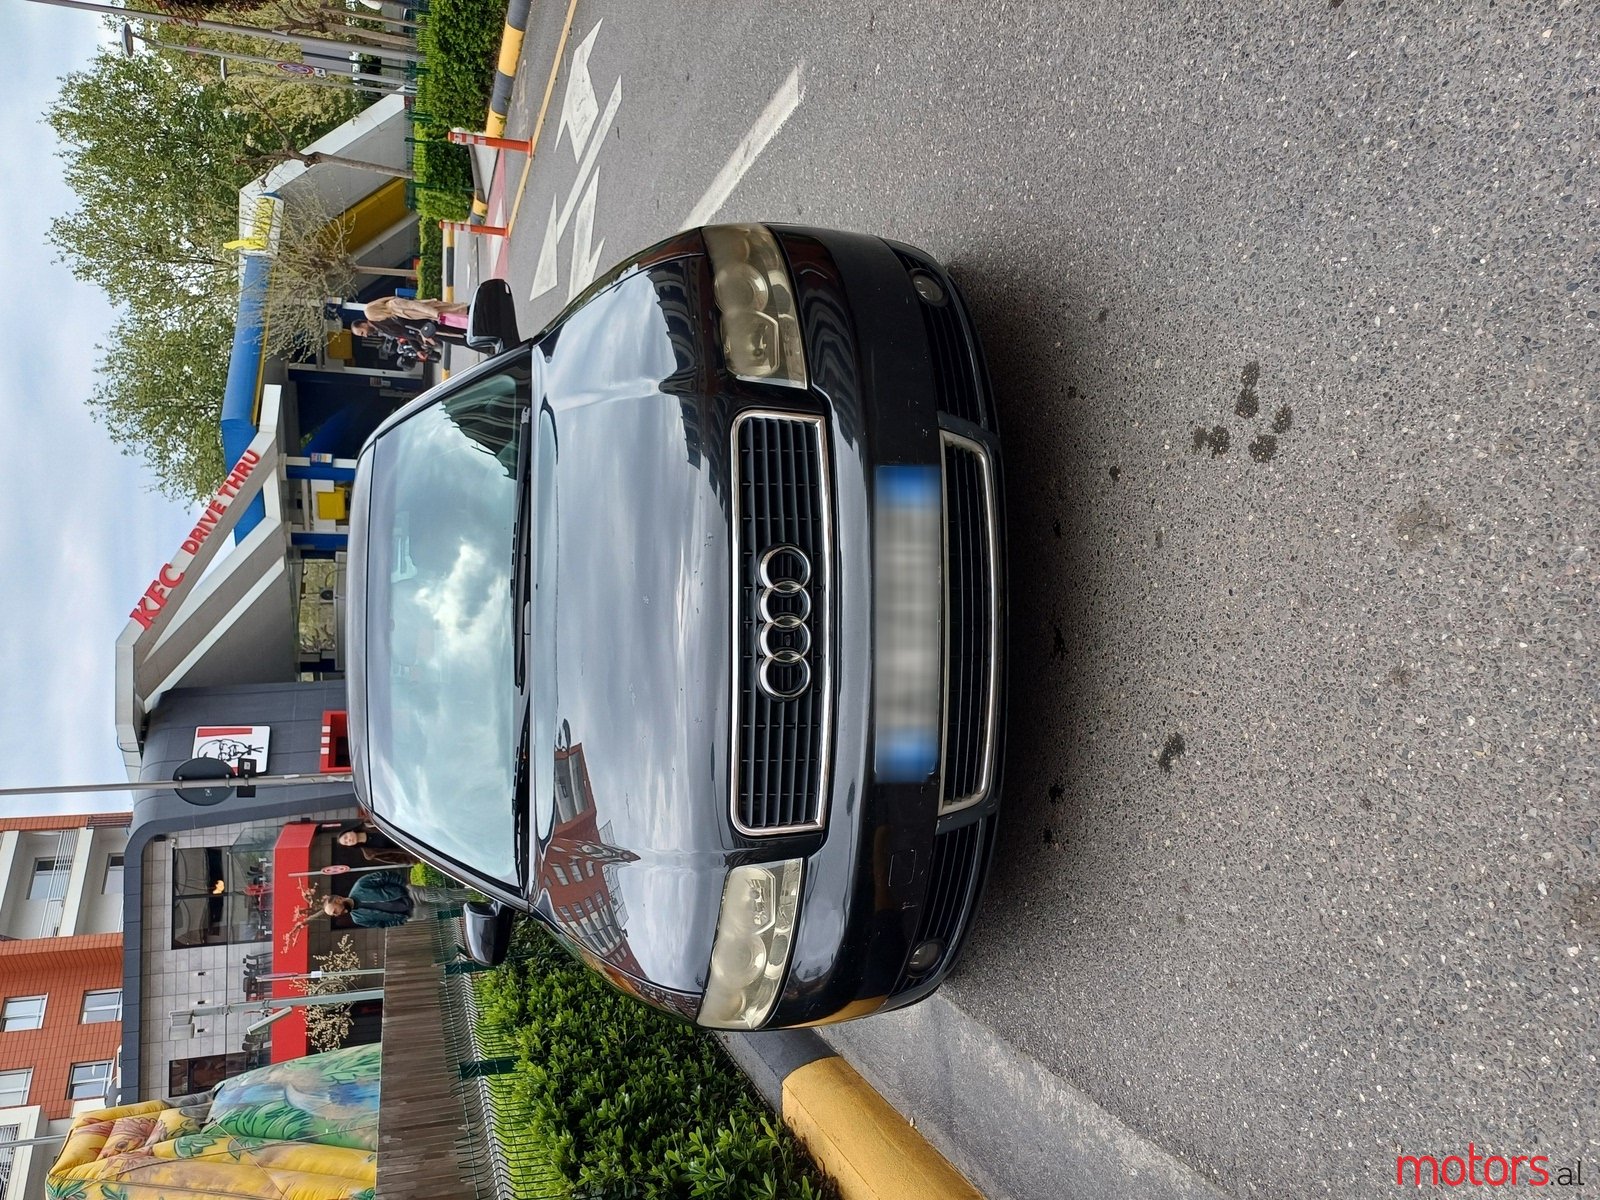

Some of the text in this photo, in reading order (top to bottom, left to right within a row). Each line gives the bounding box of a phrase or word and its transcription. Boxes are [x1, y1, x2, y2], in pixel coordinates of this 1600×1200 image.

[129, 449, 260, 631] KFC DRIVE THRU
